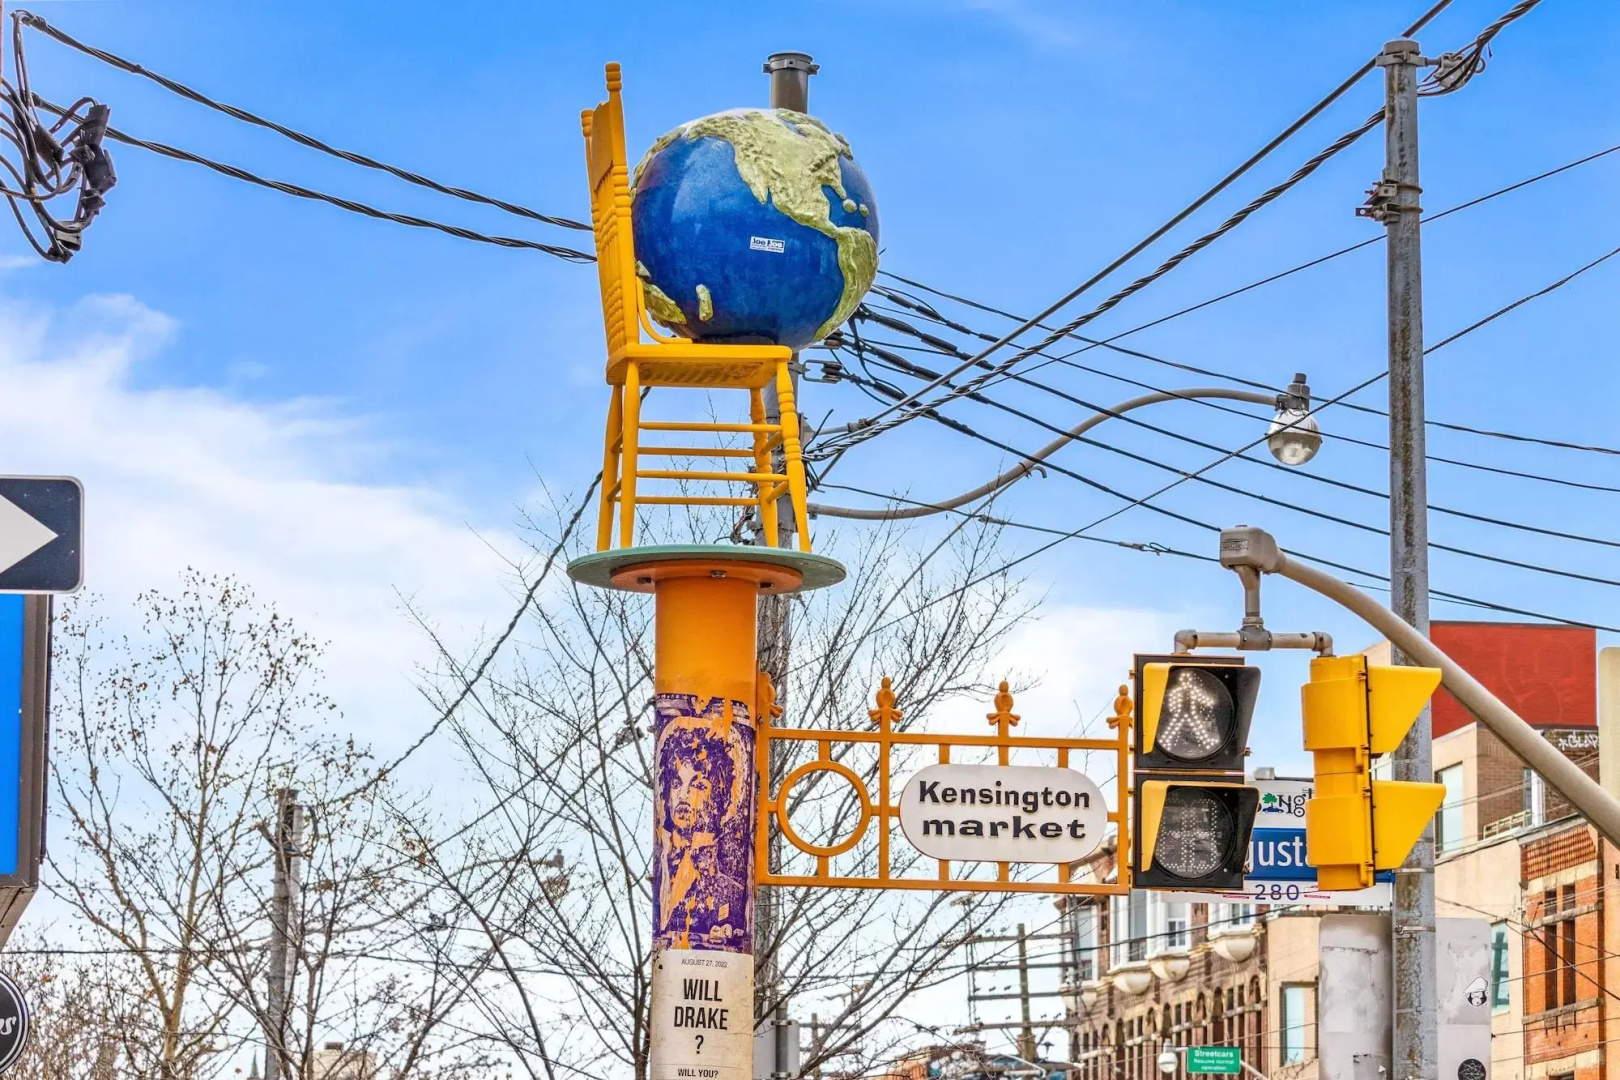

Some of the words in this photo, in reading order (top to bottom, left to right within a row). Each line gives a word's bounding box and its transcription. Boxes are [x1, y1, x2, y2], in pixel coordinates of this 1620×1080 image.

[919, 780, 1090, 814] Kensington
[922, 815, 1086, 839] market
[1254, 884, 1300, 901] 280
[681, 959, 705, 967] AUGUST
[715, 960, 728, 968] 2022
[683, 978, 722, 1002] WILL
[674, 1006, 729, 1030] DRAKE
[695, 1035, 704, 1054] ?
[1194, 1050, 1233, 1058] Streetcars
[678, 1068, 696, 1077] WILL
[698, 1069, 719, 1078] YOU?
